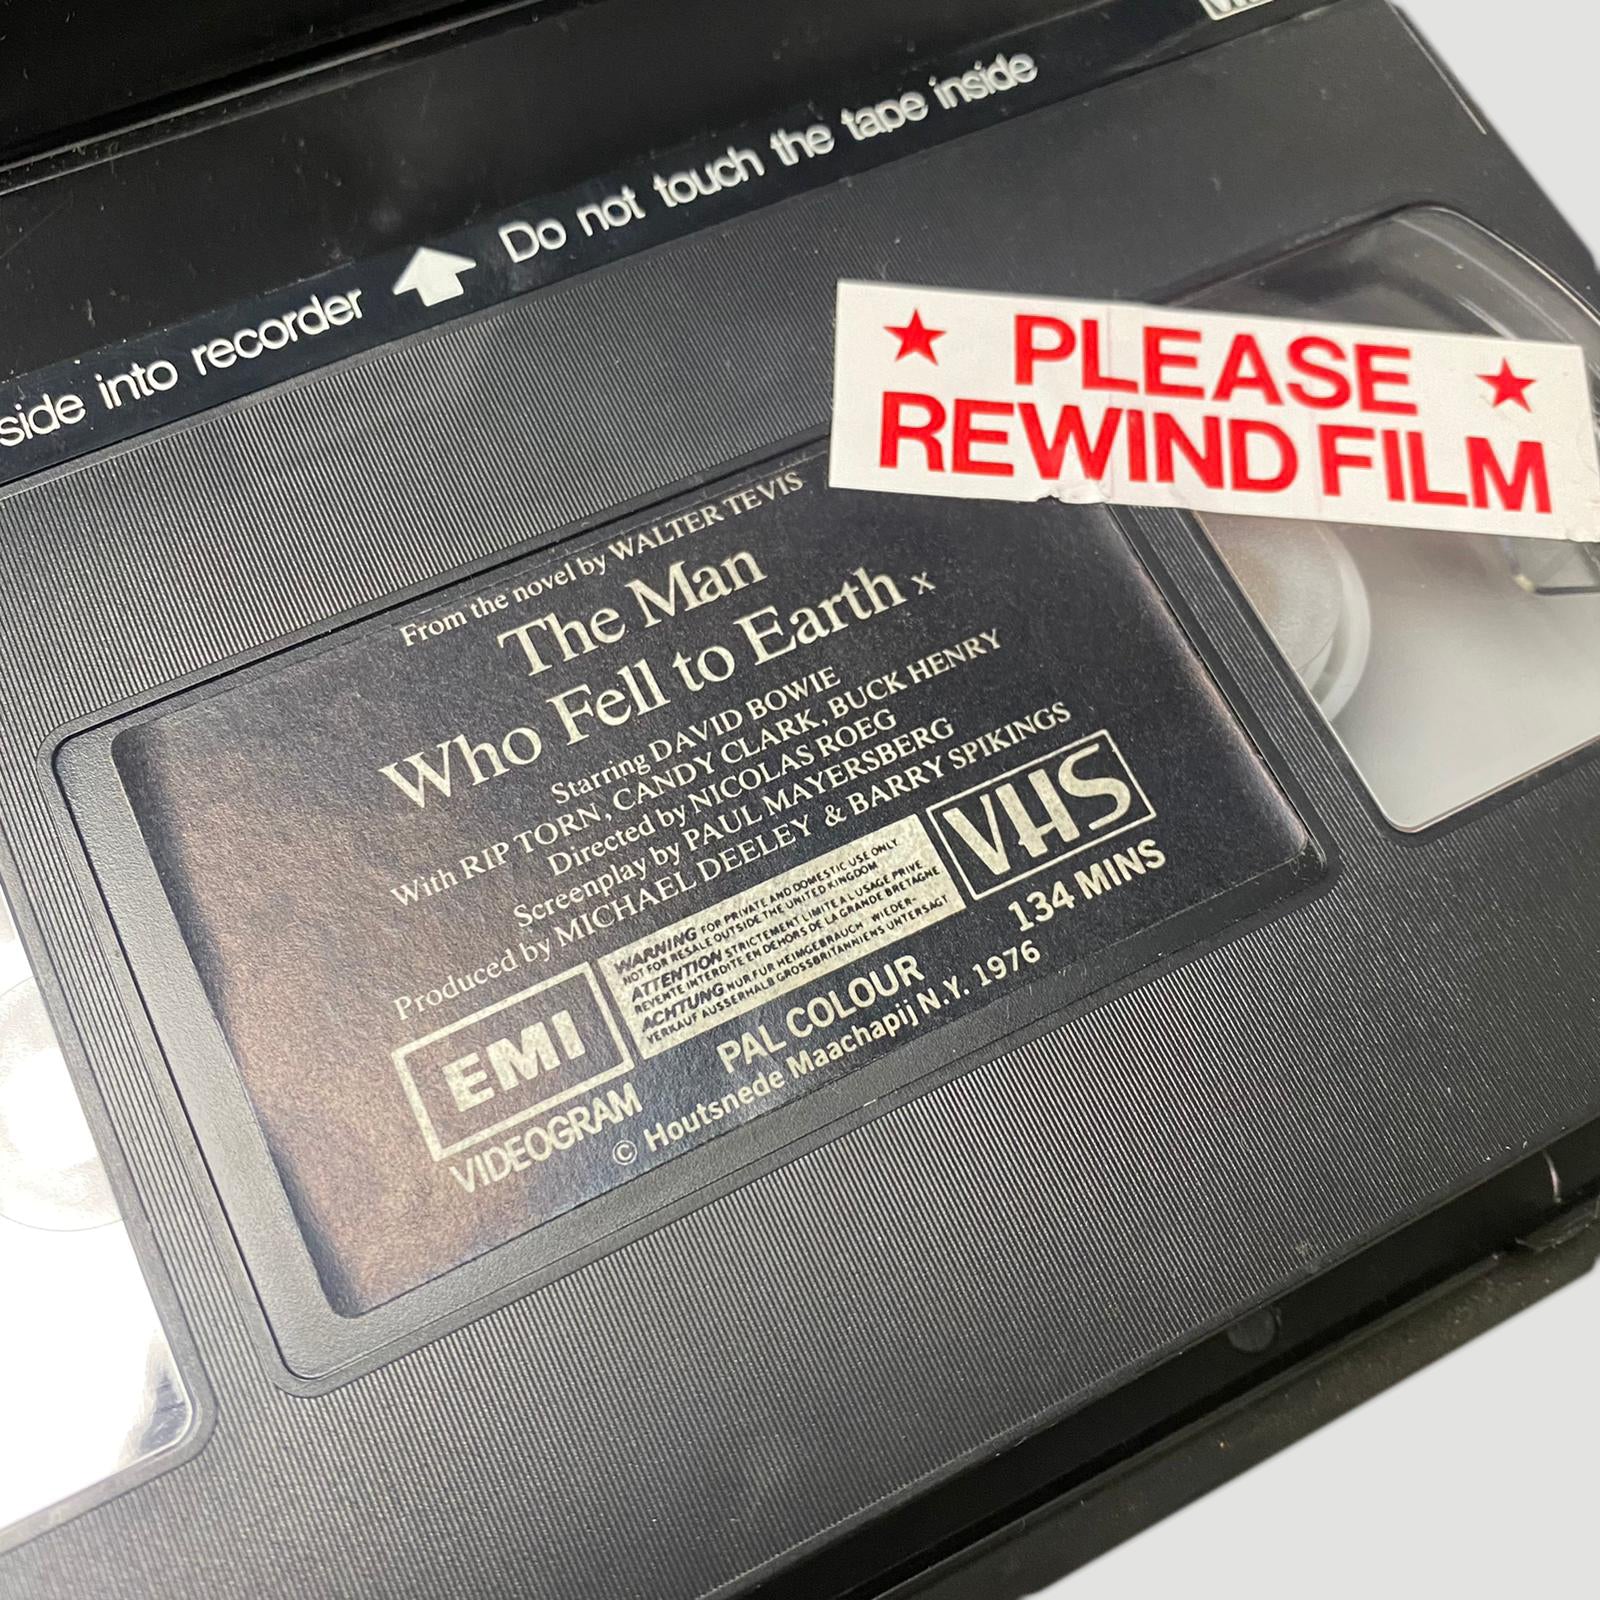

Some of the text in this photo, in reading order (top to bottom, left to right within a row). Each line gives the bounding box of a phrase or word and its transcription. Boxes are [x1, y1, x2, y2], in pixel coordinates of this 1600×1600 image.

[499, 55, 1037, 263] Do not touch the tape inside
[0, 289, 362, 446] side into recorder
[1015, 315, 1417, 415] PLEASE
[880, 392, 1551, 512] REWIND FILM
[399, 472, 802, 646] From the novel by WALTER TEVIS
[497, 551, 766, 675] The Man
[377, 727, 541, 821] Who
[545, 658, 670, 745] Fell
[672, 646, 734, 690] to
[733, 568, 906, 665] Earth
[551, 666, 840, 803] Starring DAVID BOWIE
[390, 628, 999, 905] With RIP TORN, CANDY CLARK, BUCK HENRY
[513, 717, 953, 934] Screenplay by PAUL MAYERSBERG
[546, 709, 895, 875] Directed by NICOLAS ROEG
[942, 743, 1130, 874] VHS
[389, 702, 1070, 1020] Produced by MICHAEL DEELEY & BARRY SPIKINGS
[613, 838, 897, 974] WARNING FOR PRIVATE AND DOMESTIC USE ONLY
[622, 861, 877, 985] NOT FOR RESALE OUTSIDE THE UNITED KINGDOM
[1008, 839, 1165, 931] 134 MINS
[632, 949, 721, 1002] ATTENTION
[724, 915, 799, 957] STRICTEMENT
[801, 899, 838, 921] LIMITE
[634, 984, 684, 1014] REVENTE
[686, 956, 744, 989] INTERDITE
[745, 948, 761, 961] EN
[762, 927, 807, 953] DEHORS
[808, 919, 822, 932] DE
[824, 913, 838, 924] LA
[839, 891, 883, 917] GRANDE
[642, 982, 723, 1032] ACHTUNG
[752, 963, 775, 978] FUR
[776, 922, 863, 967] HEIMGEBRAUCH
[646, 1012, 696, 1043] VERKAUF
[776, 925, 884, 981] GROSSBRITANNIENS
[886, 894, 947, 929] UNTERSAGT
[716, 955, 924, 1073] PAL COLOUR
[434, 1010, 584, 1111] EMI
[643, 1066, 785, 1151] Houtsnede
[785, 999, 918, 1078] Maachapij
[916, 975, 969, 1013] N.Y.
[972, 940, 1039, 986] 1976
[447, 1082, 642, 1192] VIDEOGRAM
